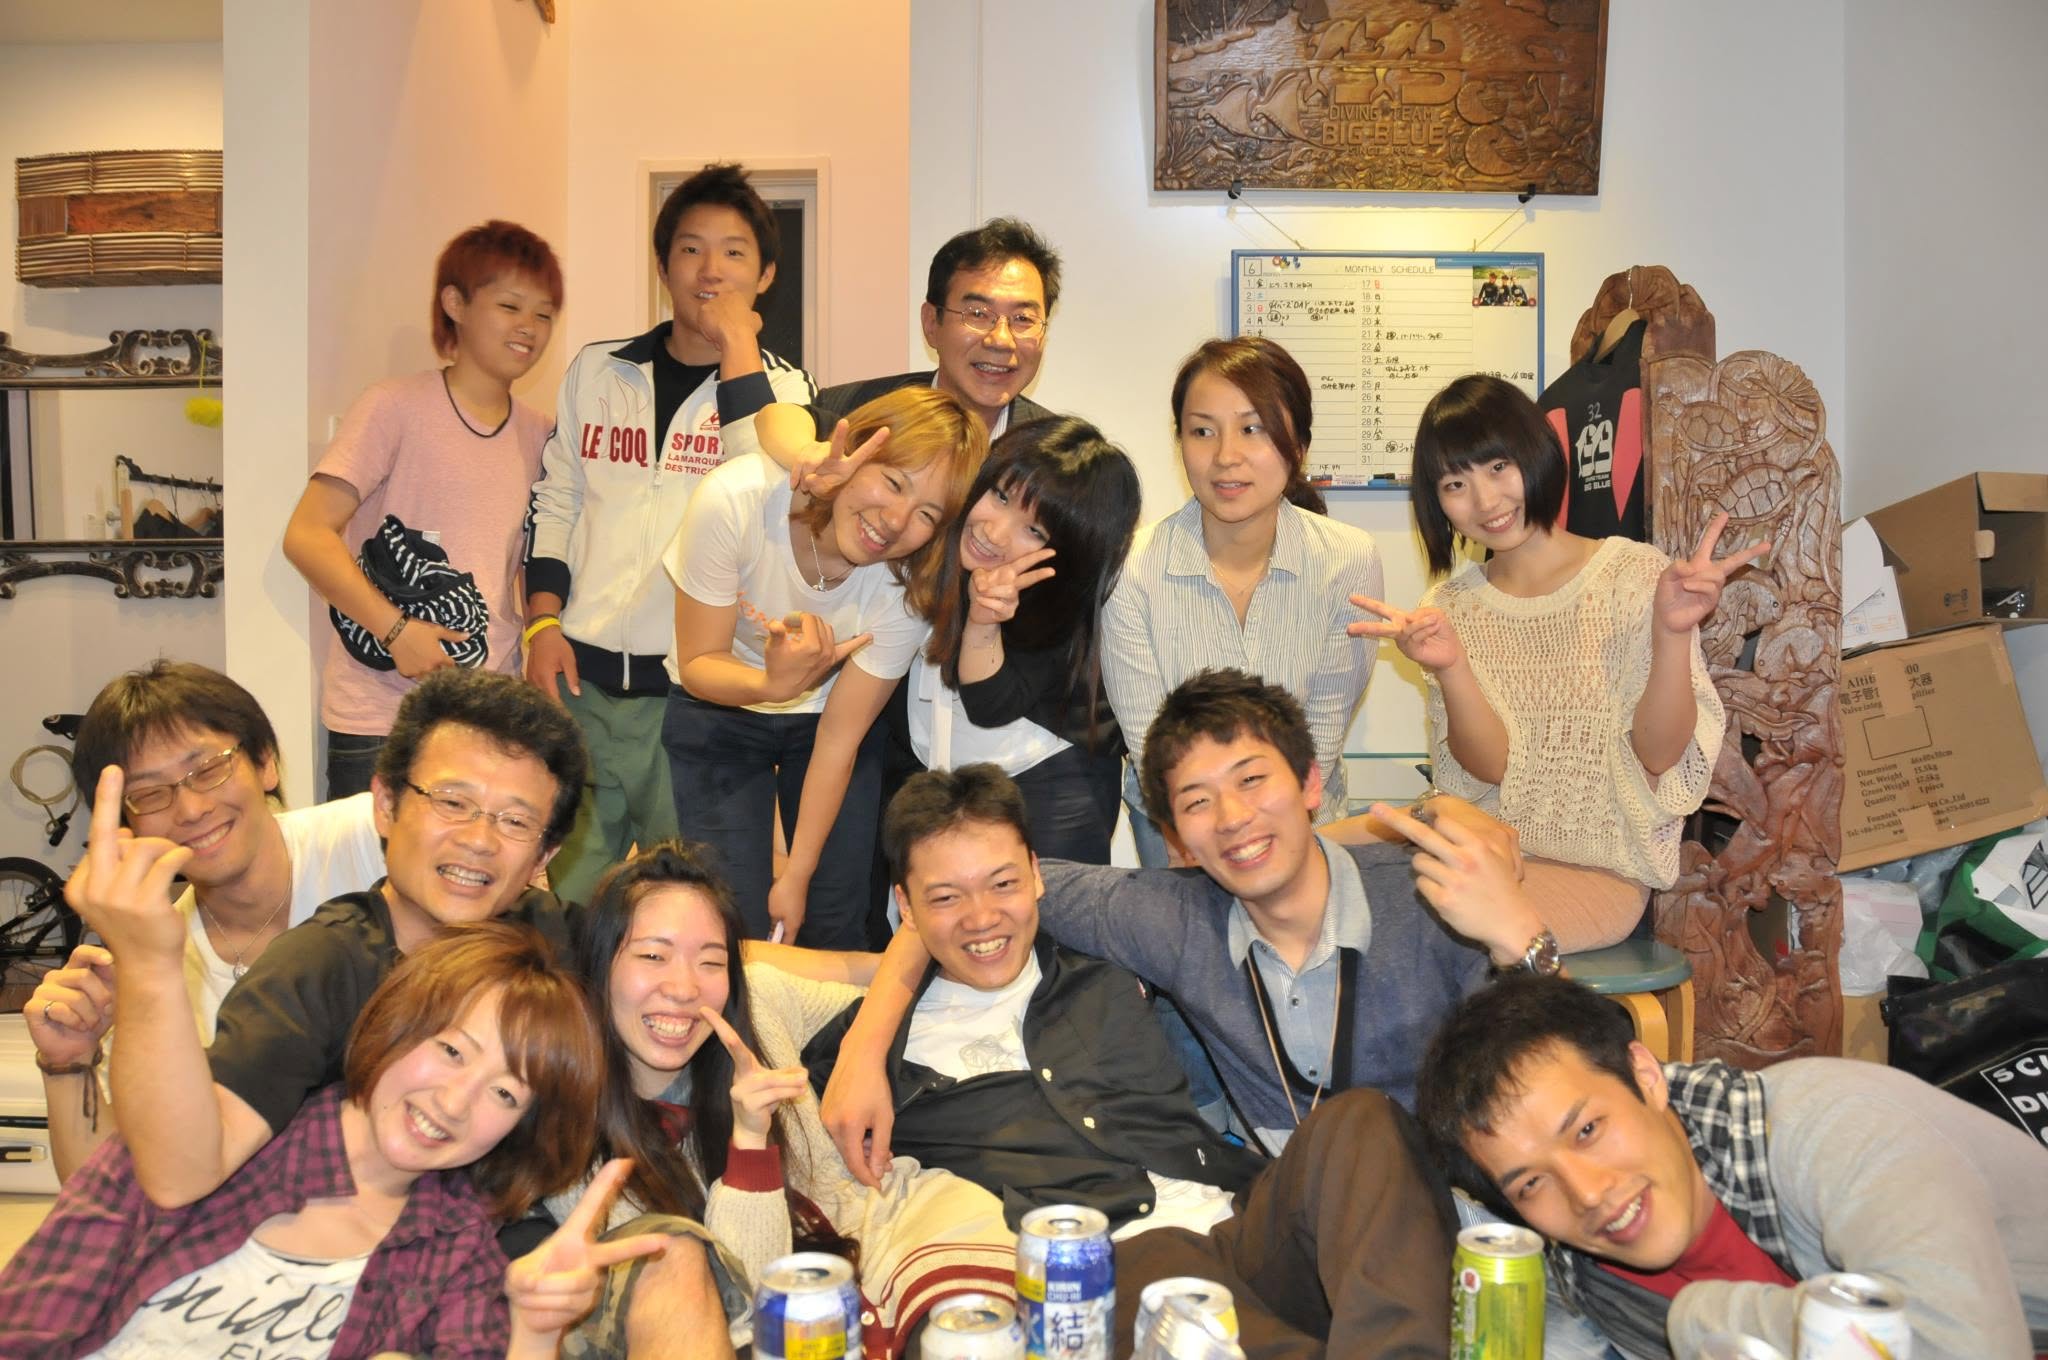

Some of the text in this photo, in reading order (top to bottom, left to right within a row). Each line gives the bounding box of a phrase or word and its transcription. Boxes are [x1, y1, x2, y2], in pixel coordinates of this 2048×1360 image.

[1328, 104, 1433, 121] DIVING TEAM
[1322, 122, 1447, 146] BIG BLUE
[1248, 262, 1256, 275] 6
[1344, 265, 1435, 274] MONTHLY SCHEDULE
[1361, 330, 1371, 338] 21
[1361, 342, 1372, 351] 22
[1361, 355, 1372, 363] 23
[1361, 367, 1371, 376] 24
[1361, 380, 1372, 388] 25
[1361, 393, 1372, 401] 26
[1361, 405, 1372, 414] 27
[1587, 401, 1603, 422] 32
[1361, 418, 1372, 426] 28
[1361, 430, 1372, 439] 29
[581, 423, 649, 468] LE COQ
[1361, 442, 1372, 451] 30
[668, 453, 680, 462] LA
[1361, 455, 1371, 464] 31
[665, 462, 683, 473] DES
[1593, 479, 1611, 490] BLUE
[1856, 763, 1898, 778] Dimension
[1876, 771, 1904, 784] Weight
[1861, 787, 1883, 797] Gross
[1883, 779, 1910, 792] Weight
[1863, 793, 1897, 808] Quantity
[1050, 1310, 1086, 1351] 結
